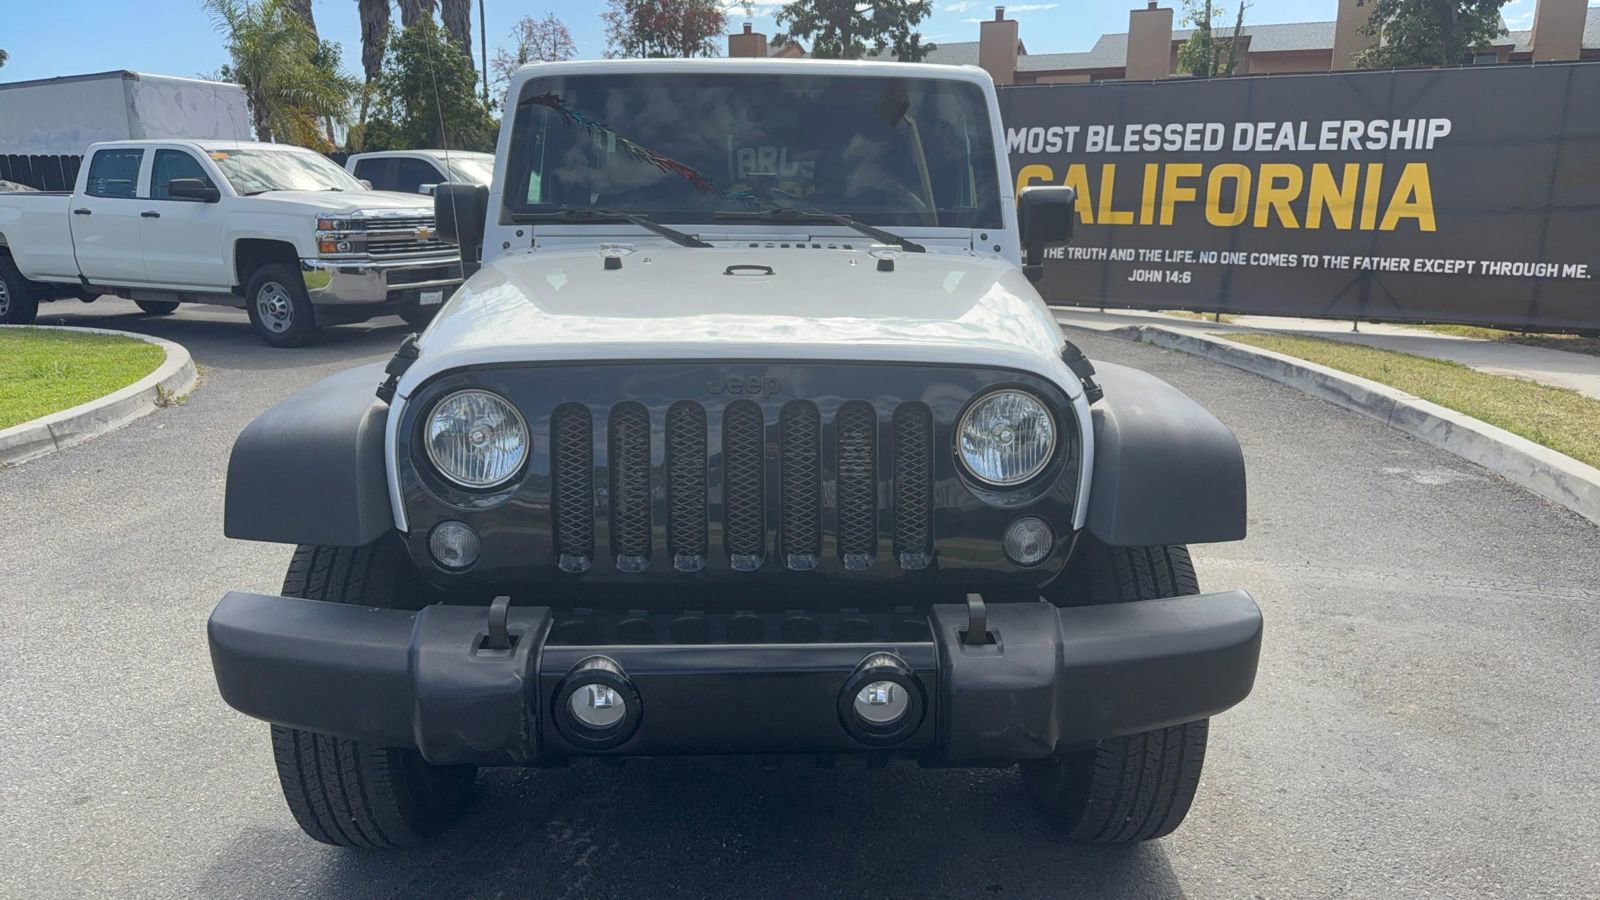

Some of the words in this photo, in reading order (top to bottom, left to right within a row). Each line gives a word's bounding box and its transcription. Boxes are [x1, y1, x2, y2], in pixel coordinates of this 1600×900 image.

[1007, 125, 1080, 153] MOST
[1085, 122, 1225, 152] BLESSED
[1232, 118, 1452, 151] DEALERSHIP
[1043, 247, 1065, 259] THE
[1067, 247, 1107, 260] TRUTH
[1108, 248, 1136, 261] AND
[1138, 249, 1163, 262] THE
[1164, 250, 1197, 263] LIFE.
[1199, 251, 1218, 264] NO
[1220, 252, 1247, 265] ONE
[1250, 253, 1298, 267] COMES
[1301, 254, 1319, 268] TO
[1322, 255, 1350, 269] THE
[1352, 256, 1411, 272] FATHER
[1413, 259, 1476, 274] EXCEPT
[1480, 261, 1559, 278] THROUGH
[1561, 264, 1591, 279] ME.
[1128, 269, 1163, 283] JOHN
[1165, 270, 1192, 283] 14:6
[704, 374, 783, 400] Jeep
